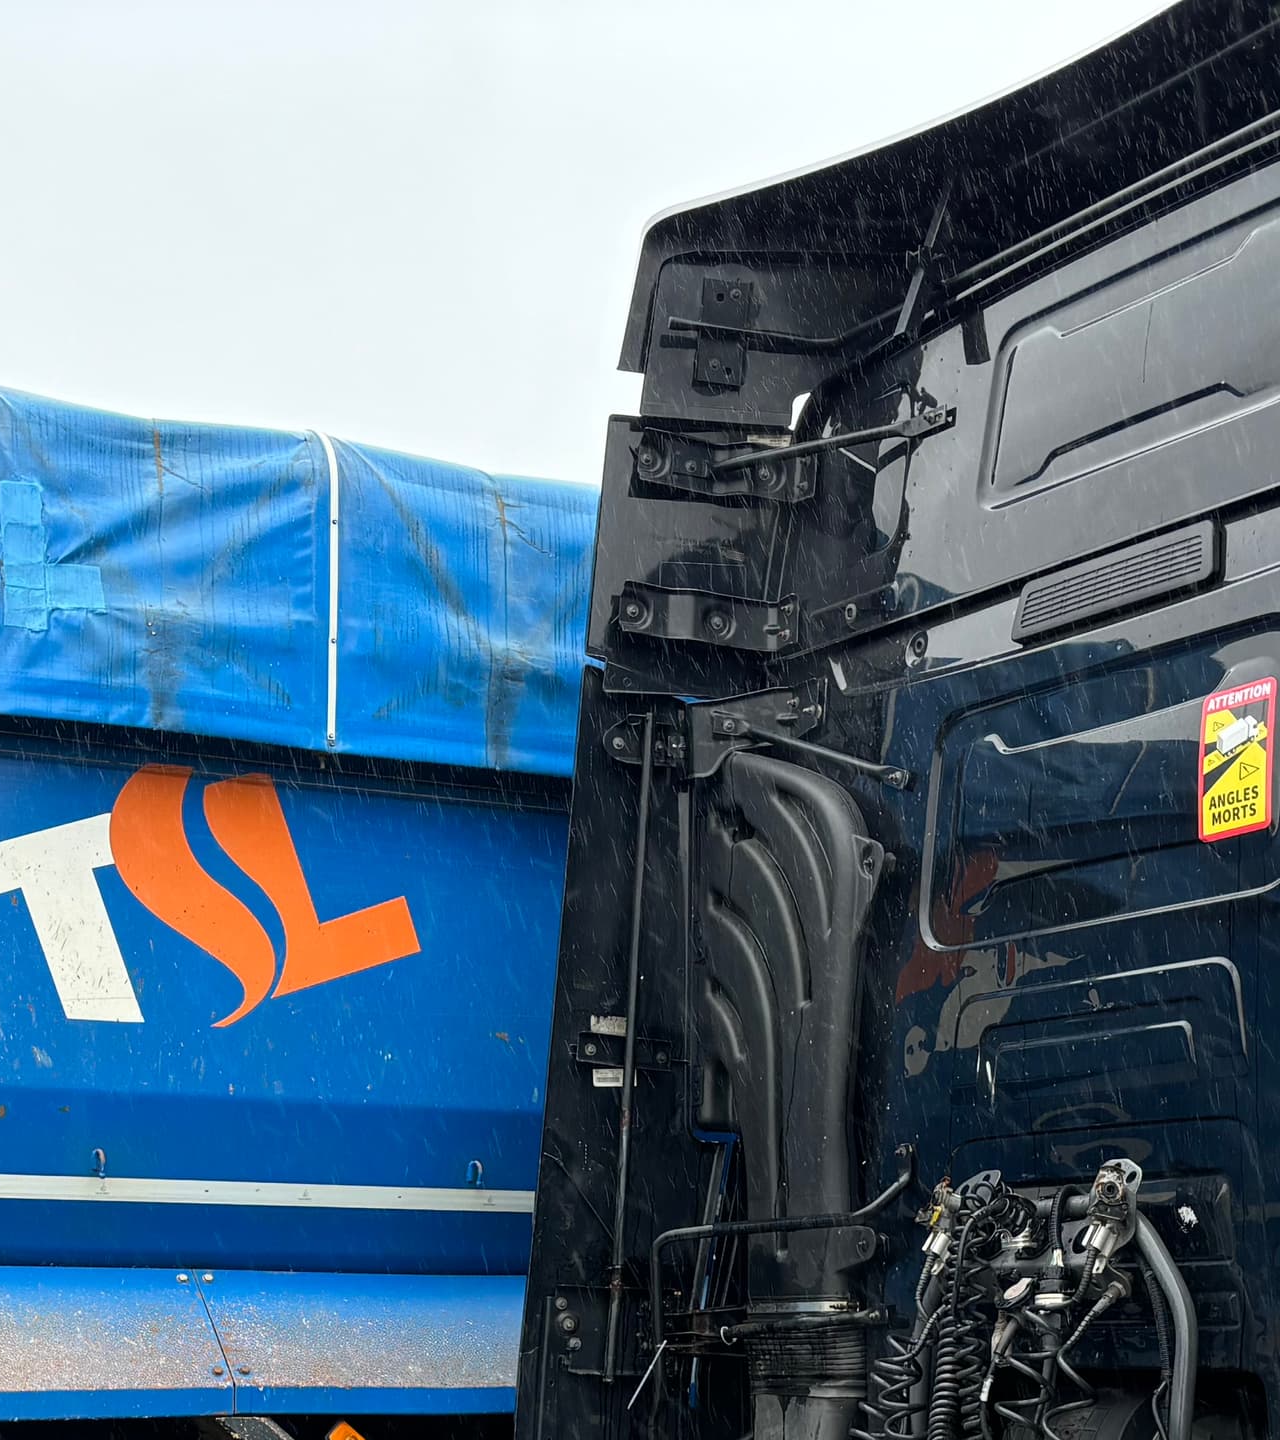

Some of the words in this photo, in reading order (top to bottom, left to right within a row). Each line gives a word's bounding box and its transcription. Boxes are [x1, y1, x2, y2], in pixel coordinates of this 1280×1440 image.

[1207, 682, 1271, 711] ATTENTION
[1209, 785, 1259, 810] ANGLES
[1211, 802, 1257, 826] MORTS
